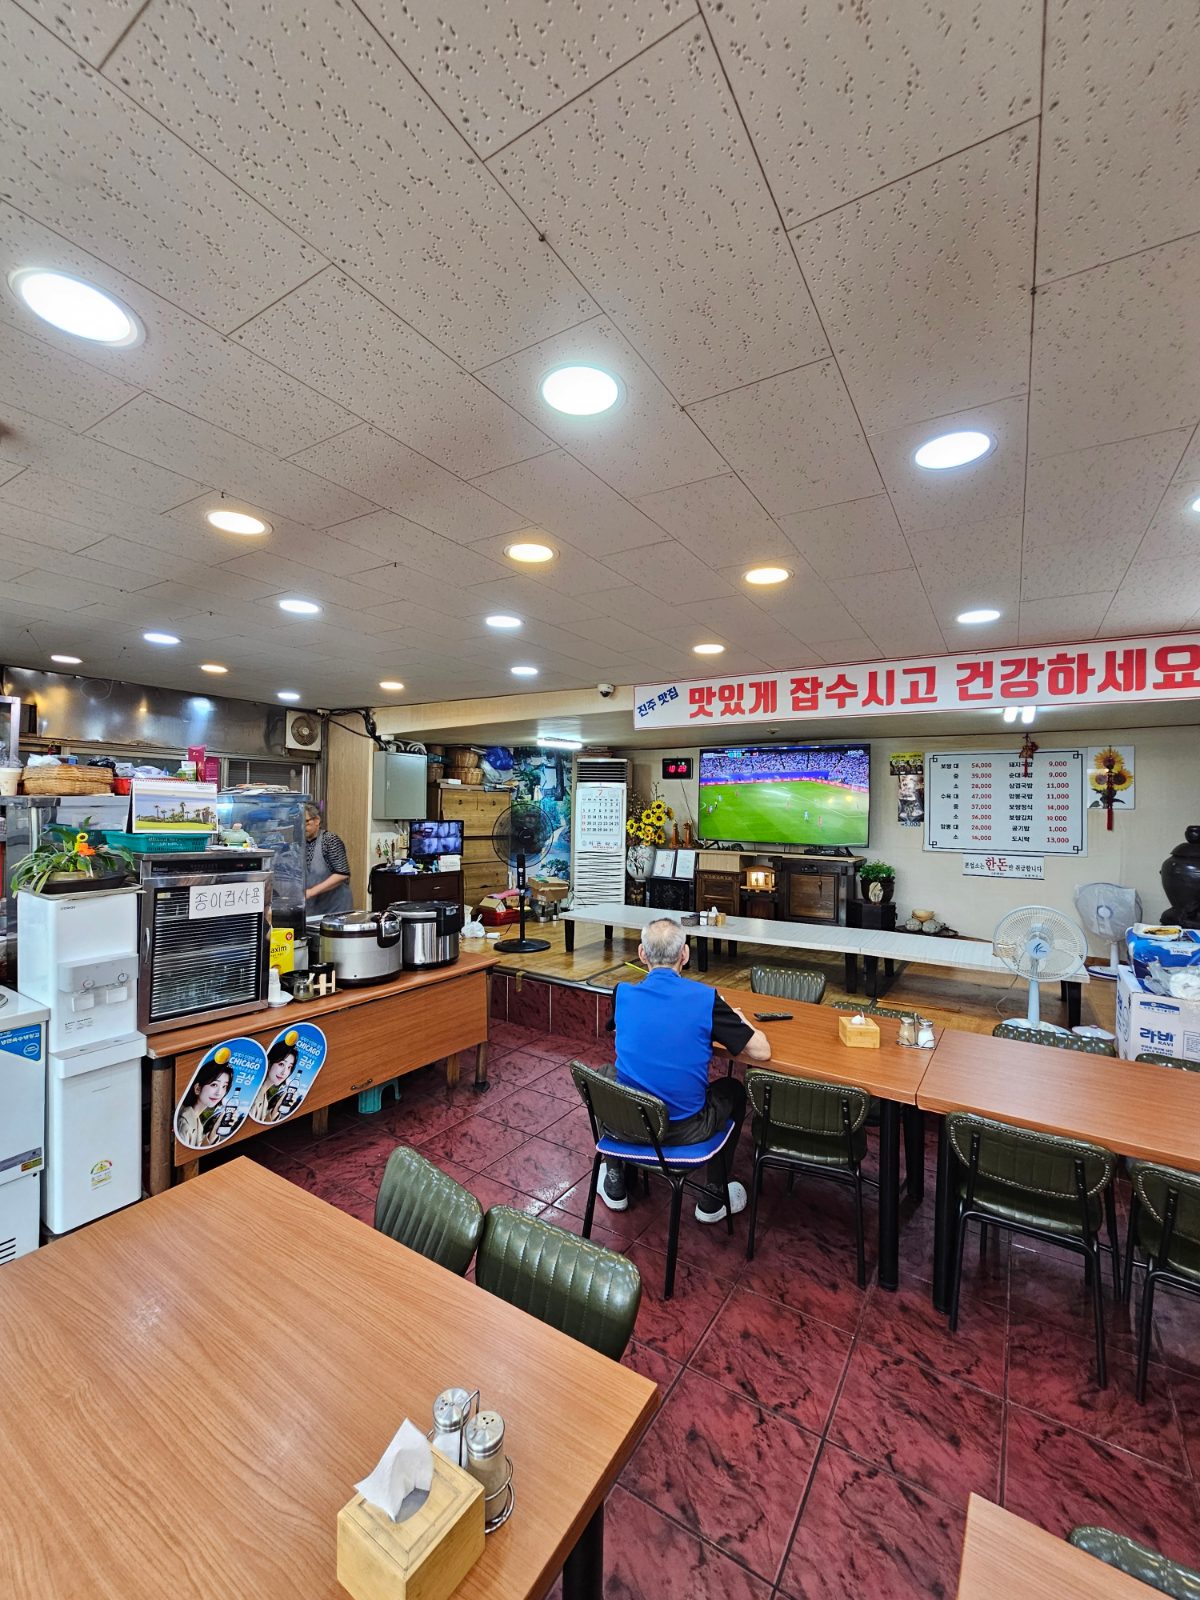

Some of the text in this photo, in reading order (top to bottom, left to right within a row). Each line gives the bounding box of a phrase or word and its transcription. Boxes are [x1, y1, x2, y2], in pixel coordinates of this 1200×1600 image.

[689, 644, 1200, 718] 맛있게 잡수시고 건강하세요
[637, 686, 680, 717] 진주 맛집
[194, 887, 261, 912] 종이컵사용
[1140, 1028, 1174, 1043] 라비
[296, 1040, 320, 1056] CHICAGO
[229, 1057, 260, 1070] CHICAGO
[299, 1055, 315, 1070] 금상
[236, 1072, 255, 1085] 금상
